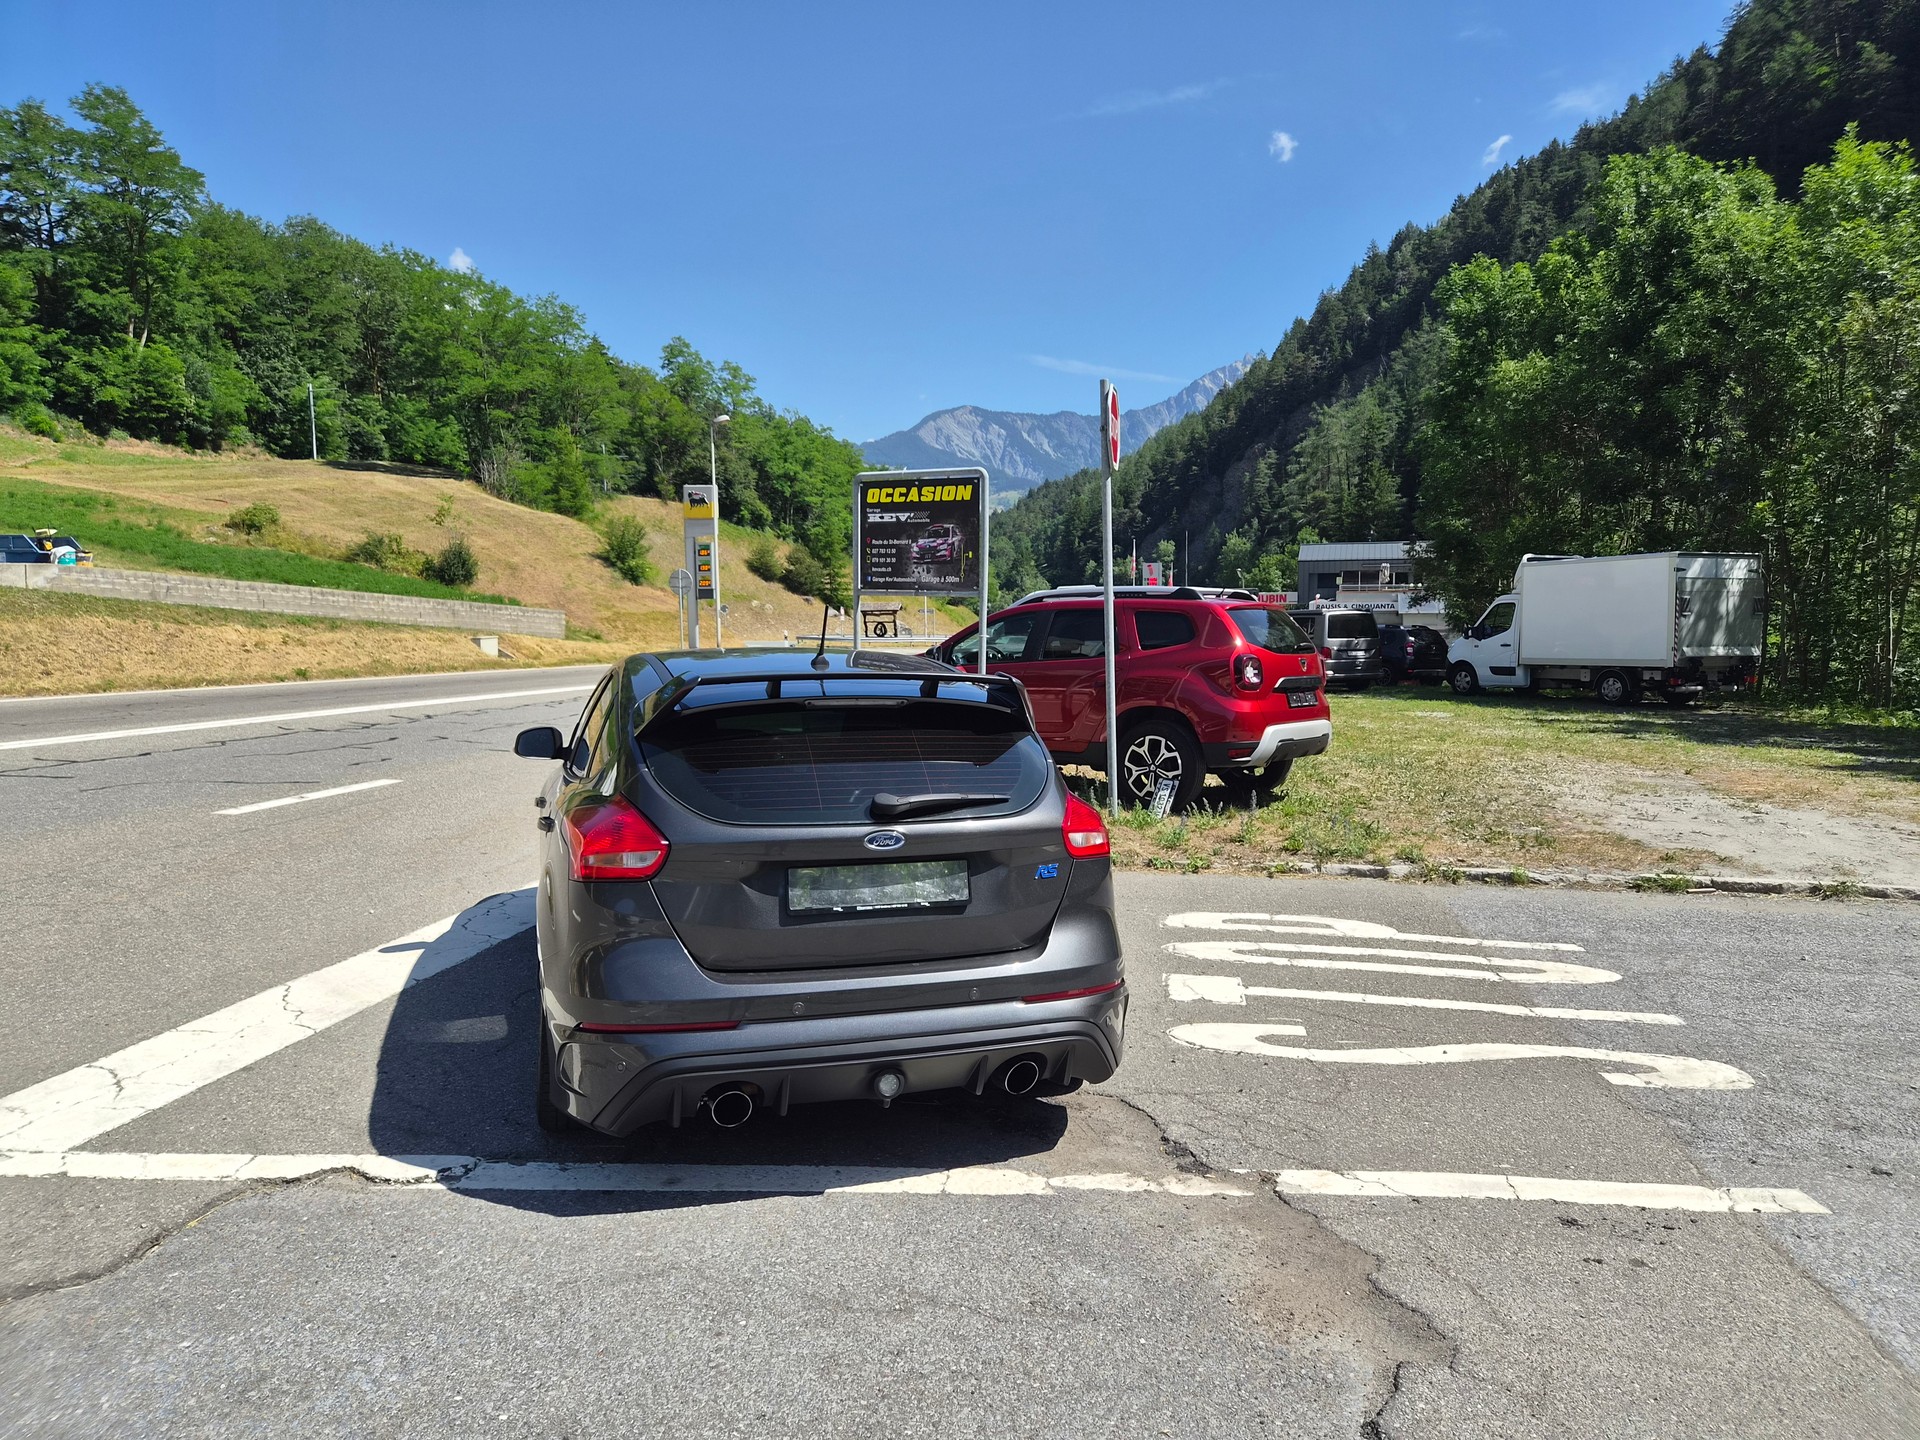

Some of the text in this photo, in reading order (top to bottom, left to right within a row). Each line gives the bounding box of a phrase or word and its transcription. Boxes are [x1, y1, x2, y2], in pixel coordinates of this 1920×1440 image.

[866, 485, 973, 503] OCCASION
[921, 576, 940, 584] Garage
[1257, 594, 1288, 604] UBIN
[873, 835, 896, 846] Ford
[1034, 863, 1060, 880] RS
